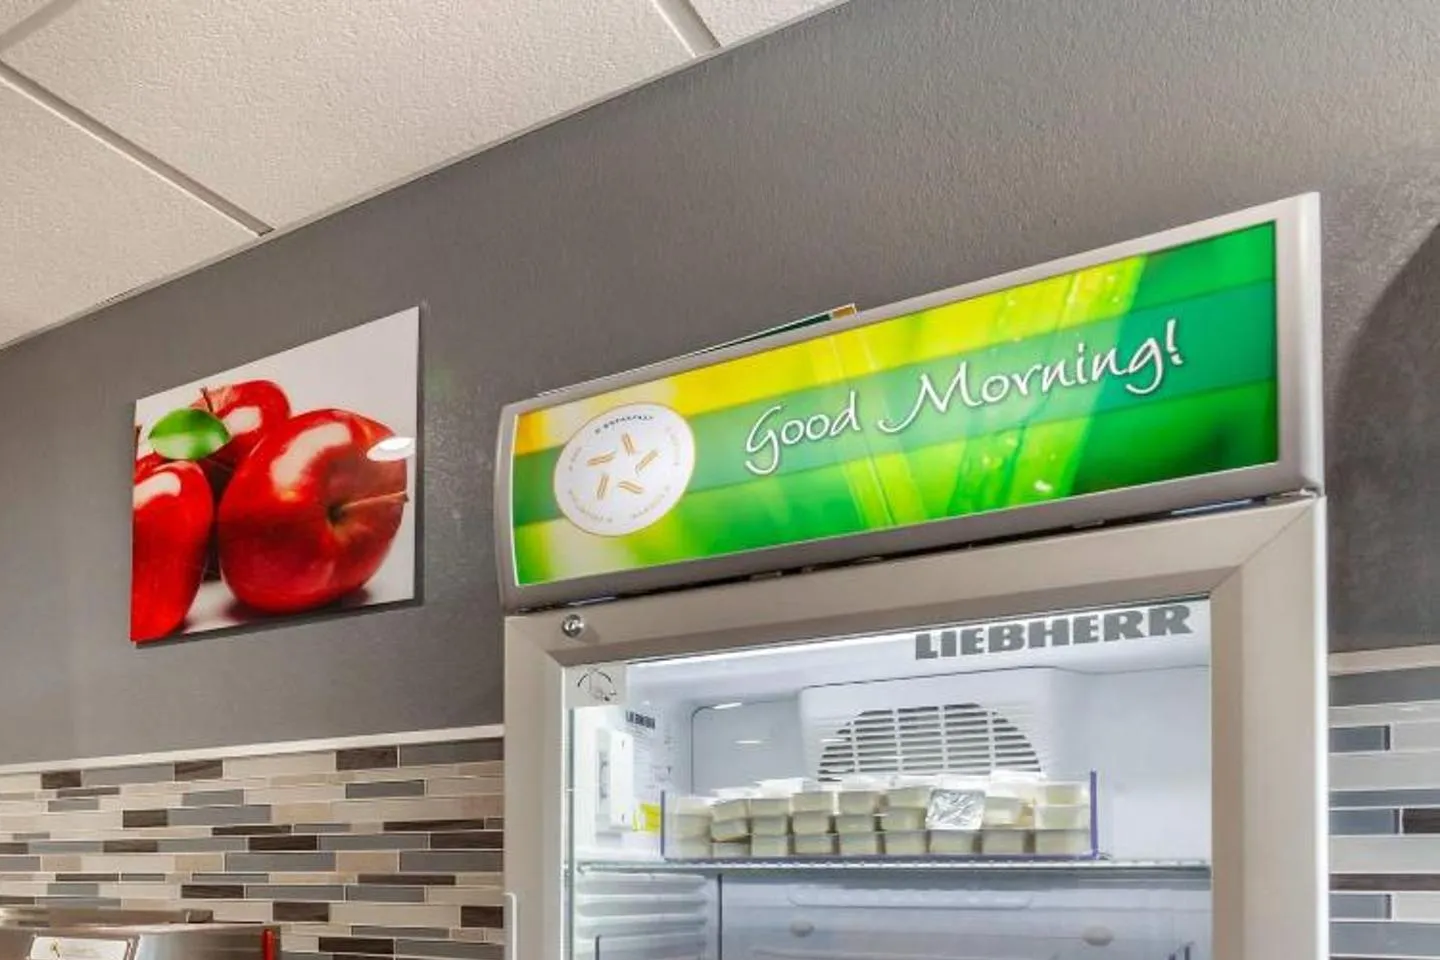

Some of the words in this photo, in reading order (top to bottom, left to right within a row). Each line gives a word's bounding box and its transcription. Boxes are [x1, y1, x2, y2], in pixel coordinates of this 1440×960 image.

[743, 390, 861, 475] Good
[878, 318, 1185, 434] Morning!
[915, 604, 1193, 660] LIEBHERR
